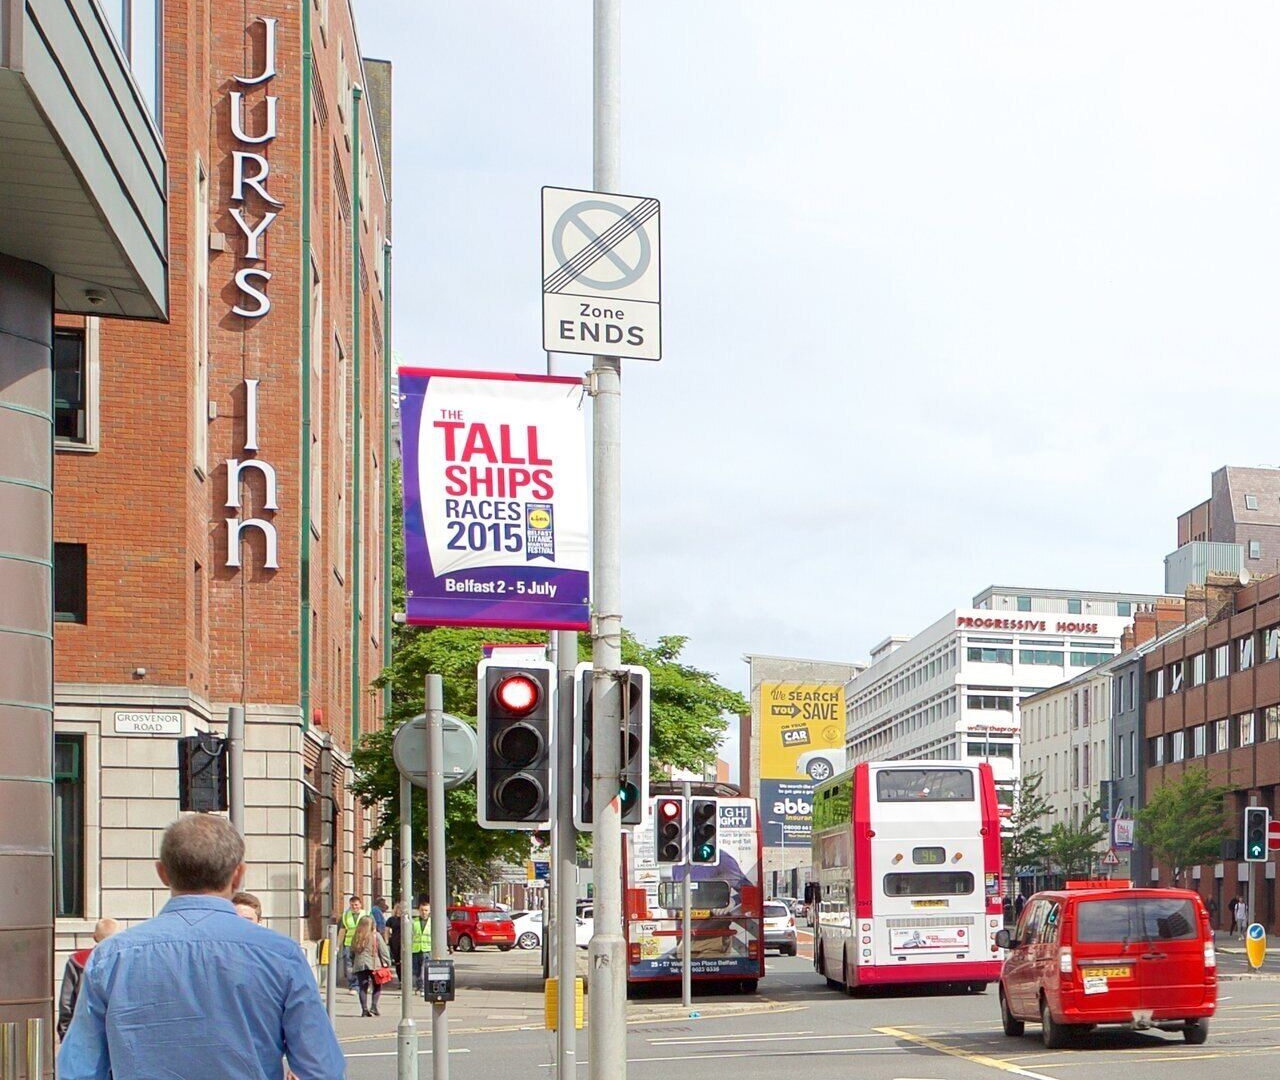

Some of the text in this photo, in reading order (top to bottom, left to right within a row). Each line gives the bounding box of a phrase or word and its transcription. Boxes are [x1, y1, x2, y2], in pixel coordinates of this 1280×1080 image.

[228, 17, 284, 319] JURYS
[580, 303, 624, 320] Zone
[560, 320, 644, 346] ENDS
[440, 409, 464, 420] THE
[433, 421, 553, 466] TALL
[445, 465, 554, 500] SHIPS
[445, 499, 521, 521] RACES
[447, 521, 523, 553] 2015
[445, 579, 495, 594] Belfast
[496, 581, 506, 593] 2
[517, 582, 525, 594] 5
[527, 582, 557, 597] July
[957, 616, 1098, 633] PROGRESSIVE HOUSE
[771, 690, 838, 702] We SEARCH
[117, 714, 179, 723] GROSVENOR
[803, 703, 838, 720] SAVE
[134, 723, 163, 731] ROAD
[784, 730, 806, 741] CAR
[773, 797, 813, 815] abb
[720, 817, 748, 825] GHTY
